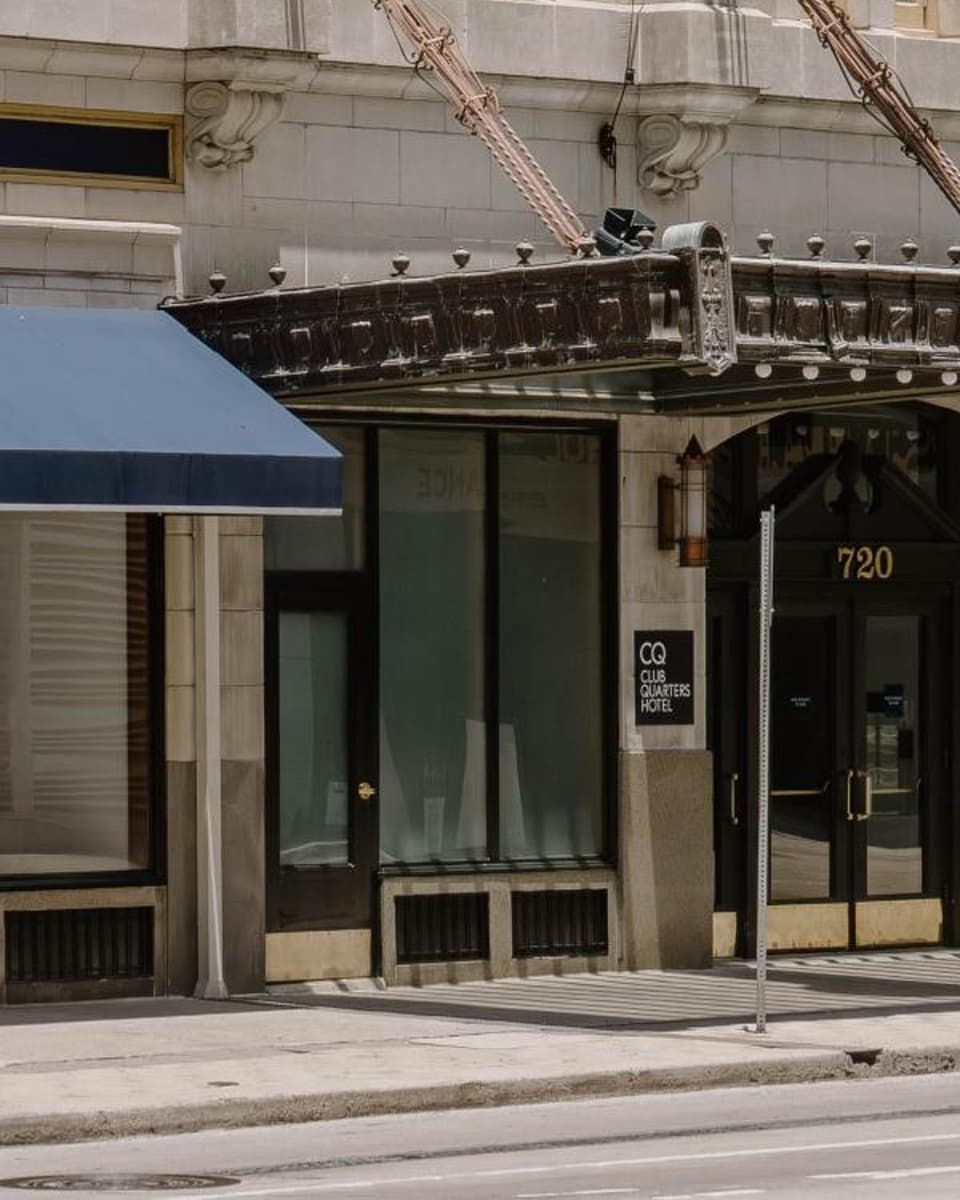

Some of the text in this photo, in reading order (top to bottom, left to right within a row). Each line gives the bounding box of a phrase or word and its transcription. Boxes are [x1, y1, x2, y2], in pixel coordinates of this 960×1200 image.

[837, 546, 893, 579] 720
[640, 642, 666, 665] CQ
[640, 670, 666, 683] CLUB
[640, 683, 691, 698] QUARTERS
[641, 698, 673, 712] HOTEL
